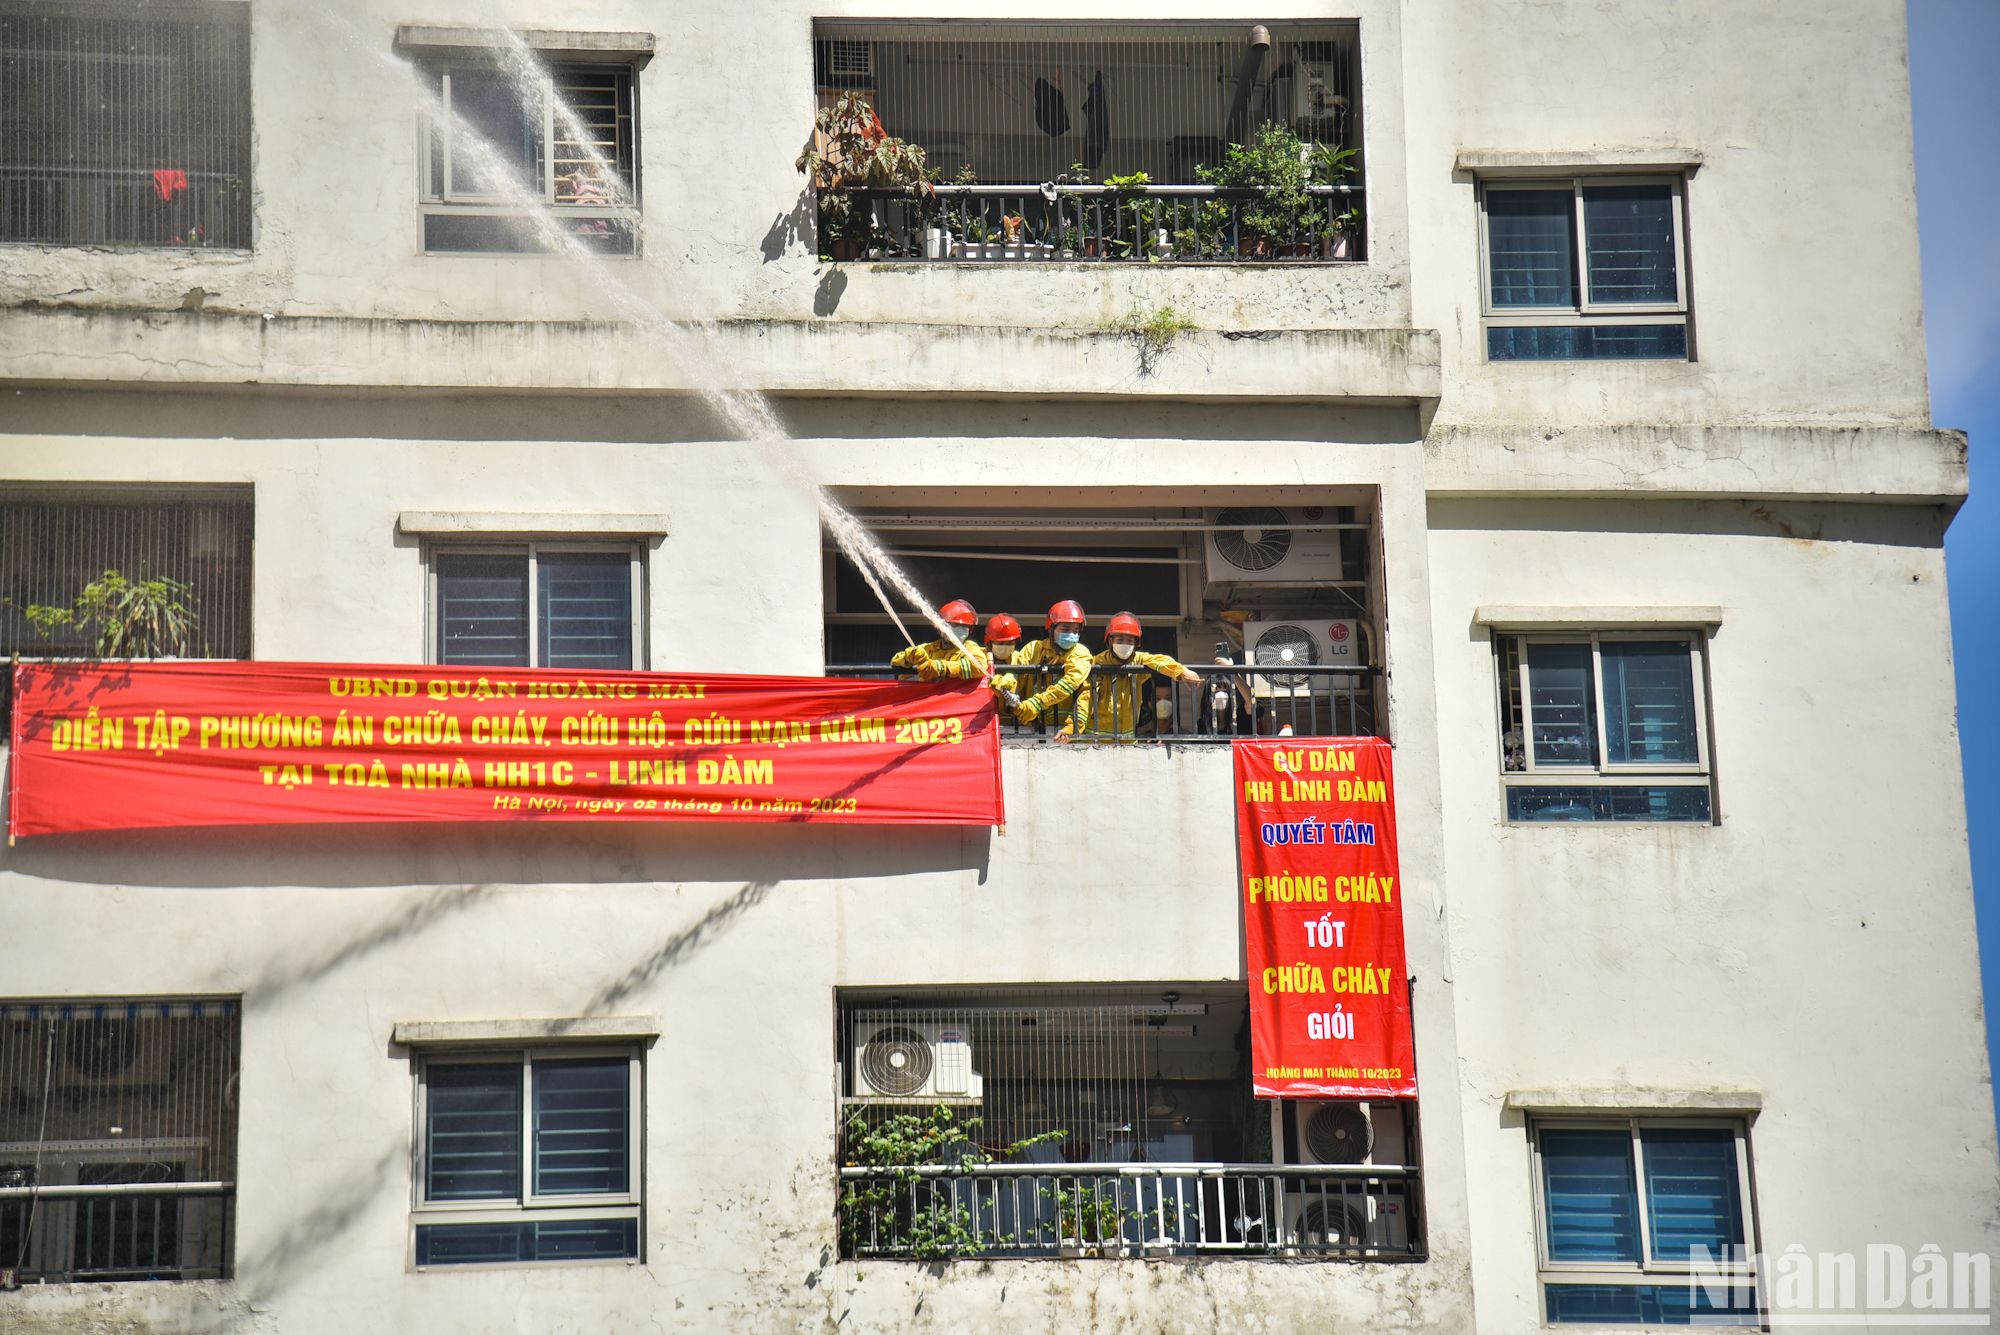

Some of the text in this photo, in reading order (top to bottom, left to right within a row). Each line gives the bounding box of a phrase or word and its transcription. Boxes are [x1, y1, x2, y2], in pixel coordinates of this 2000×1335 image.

[1331, 644, 1349, 656] LG
[329, 677, 706, 702] UBND QUẬN HOÀNG MAI
[51, 705, 124, 752] DIỄN
[133, 709, 191, 757] TẬP
[200, 712, 323, 750] PHƯƠNG
[332, 709, 373, 747] ÁN
[384, 709, 463, 746] CHỮA
[560, 709, 619, 746] CỨU
[684, 711, 741, 745] CỨU
[750, 719, 812, 749] NẠN
[819, 714, 887, 744] NĂM
[894, 716, 964, 745] 2023
[259, 764, 313, 791] TẠI
[324, 758, 391, 789] TOÀ
[401, 757, 473, 790] NHÀ
[484, 761, 574, 786] HH1C
[609, 759, 687, 785] LINH
[696, 753, 774, 785] ĐÀM
[1272, 746, 1356, 773] CƯ DÂN
[493, 795, 521, 810] Hà
[575, 799, 627, 813] ngày
[632, 799, 658, 810] 02
[663, 798, 723, 813] tháng
[730, 798, 754, 812] 10
[759, 798, 803, 813] năm
[809, 797, 857, 814] 2023
[1244, 776, 1387, 803] HH LINH ĐÀM
[1261, 816, 1376, 847] QUYẾT TÂM
[1248, 870, 1395, 904] PHÒNG CHÁY
[1303, 911, 1346, 948] TỐT
[1262, 961, 1393, 995] CHỮA CHÁY
[1307, 1003, 1355, 1041] GIỎI
[1266, 1065, 1402, 1080] HOÀNG MAI THÁNG 10/2023
